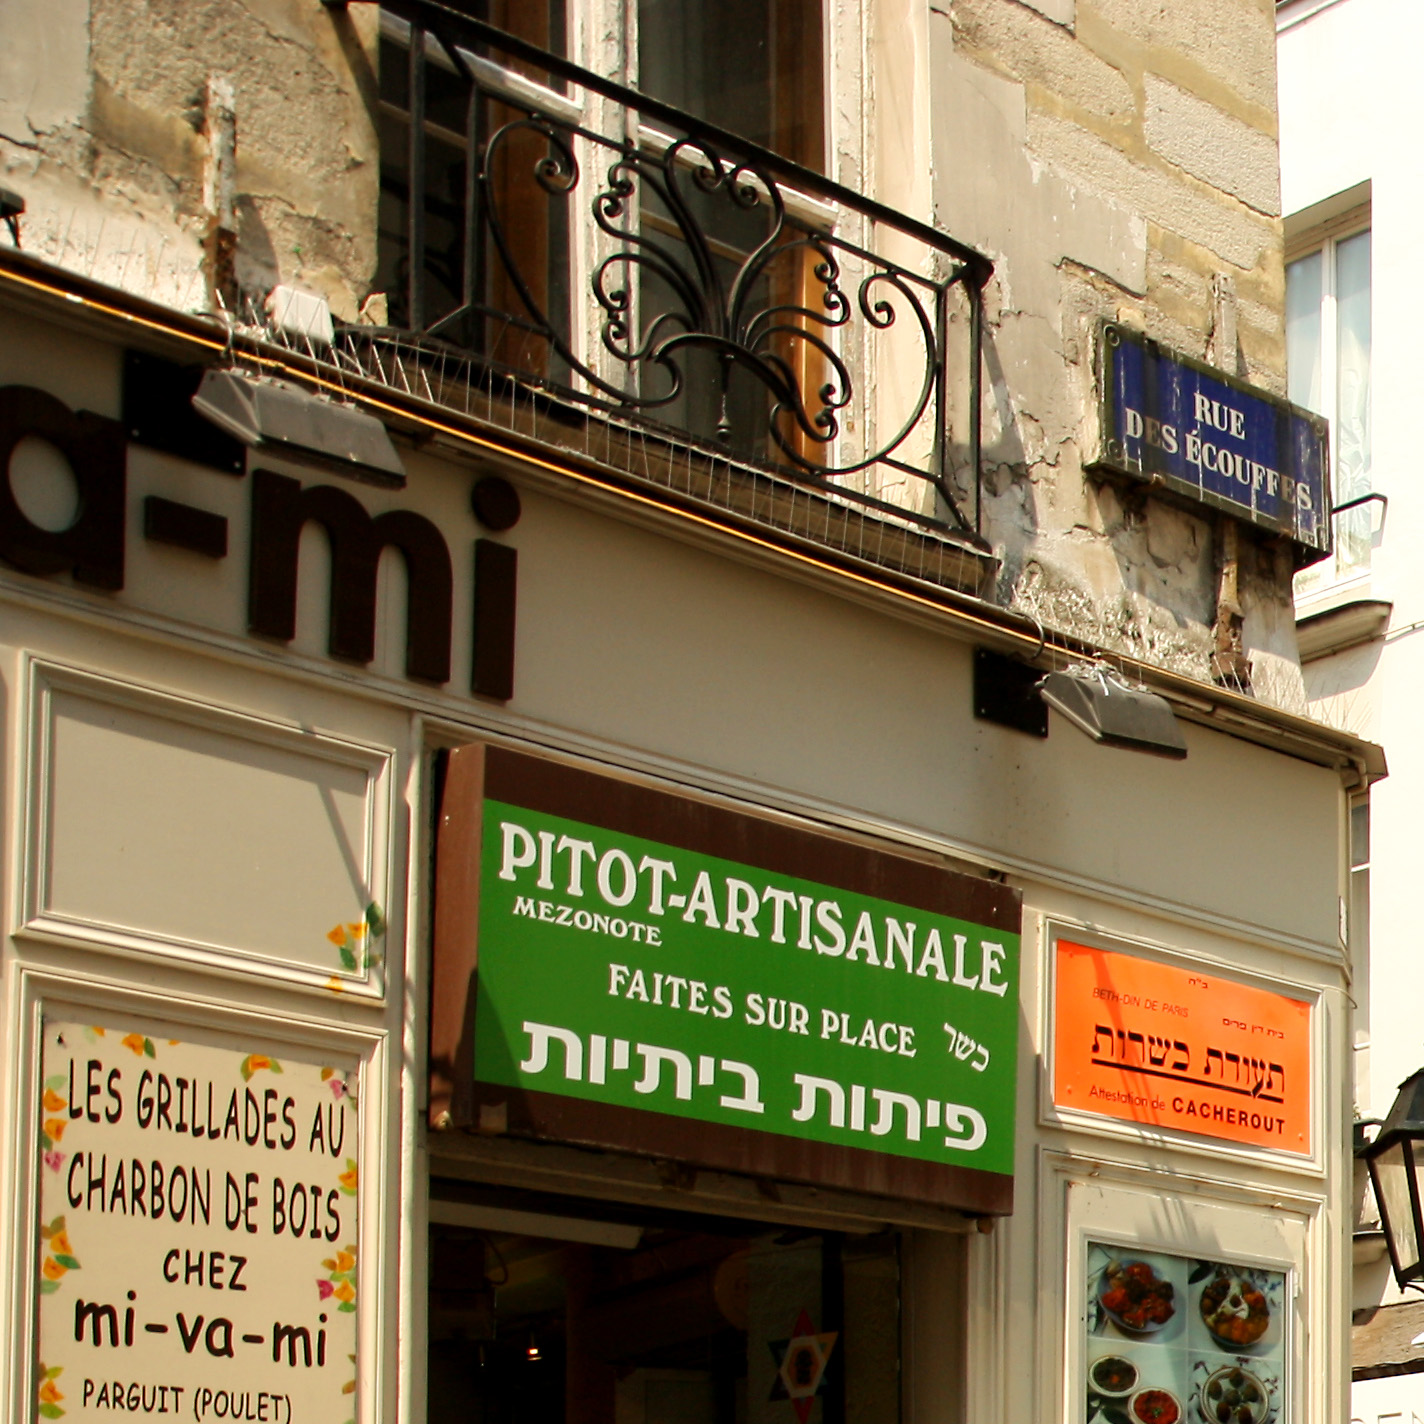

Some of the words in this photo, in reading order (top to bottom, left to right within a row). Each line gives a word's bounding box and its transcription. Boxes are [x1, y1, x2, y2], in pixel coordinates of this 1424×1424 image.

[1194, 392, 1245, 440] RUE
[1125, 407, 1178, 454] DES
[1185, 429, 1313, 510] ÉCOUFFES
[500, 822, 1008, 997] PITOT-ARTISANALE
[513, 896, 662, 946] MEZONOTE
[608, 964, 733, 1019] FAITES
[745, 994, 809, 1036] SUR
[821, 1009, 917, 1058] PLACE
[1092, 987, 1141, 1008] BETH-DIN
[1145, 997, 1159, 1012] DE
[1161, 1002, 1190, 1018] PARIS
[520, 1020, 765, 1113] ביתיות
[943, 1022, 990, 1073] כשר
[1091, 1023, 1190, 1072] כשרות
[1204, 1047, 1286, 1099] תעודת
[68, 1058, 122, 1124] LES
[137, 1069, 296, 1151] GRILLADES
[310, 1102, 345, 1158] AU
[792, 1072, 989, 1151] פיתות
[1089, 1085, 1148, 1108] Attestation
[1151, 1095, 1166, 1111] de
[1172, 1096, 1286, 1135] CACHEROUT
[67, 1151, 210, 1226] CHARBON
[225, 1171, 260, 1234] DE
[273, 1177, 341, 1243] BOIS
[163, 1249, 247, 1291] CHEZ
[74, 1290, 328, 1368] mi-va-mi
[82, 1379, 184, 1414] PARGUIT
